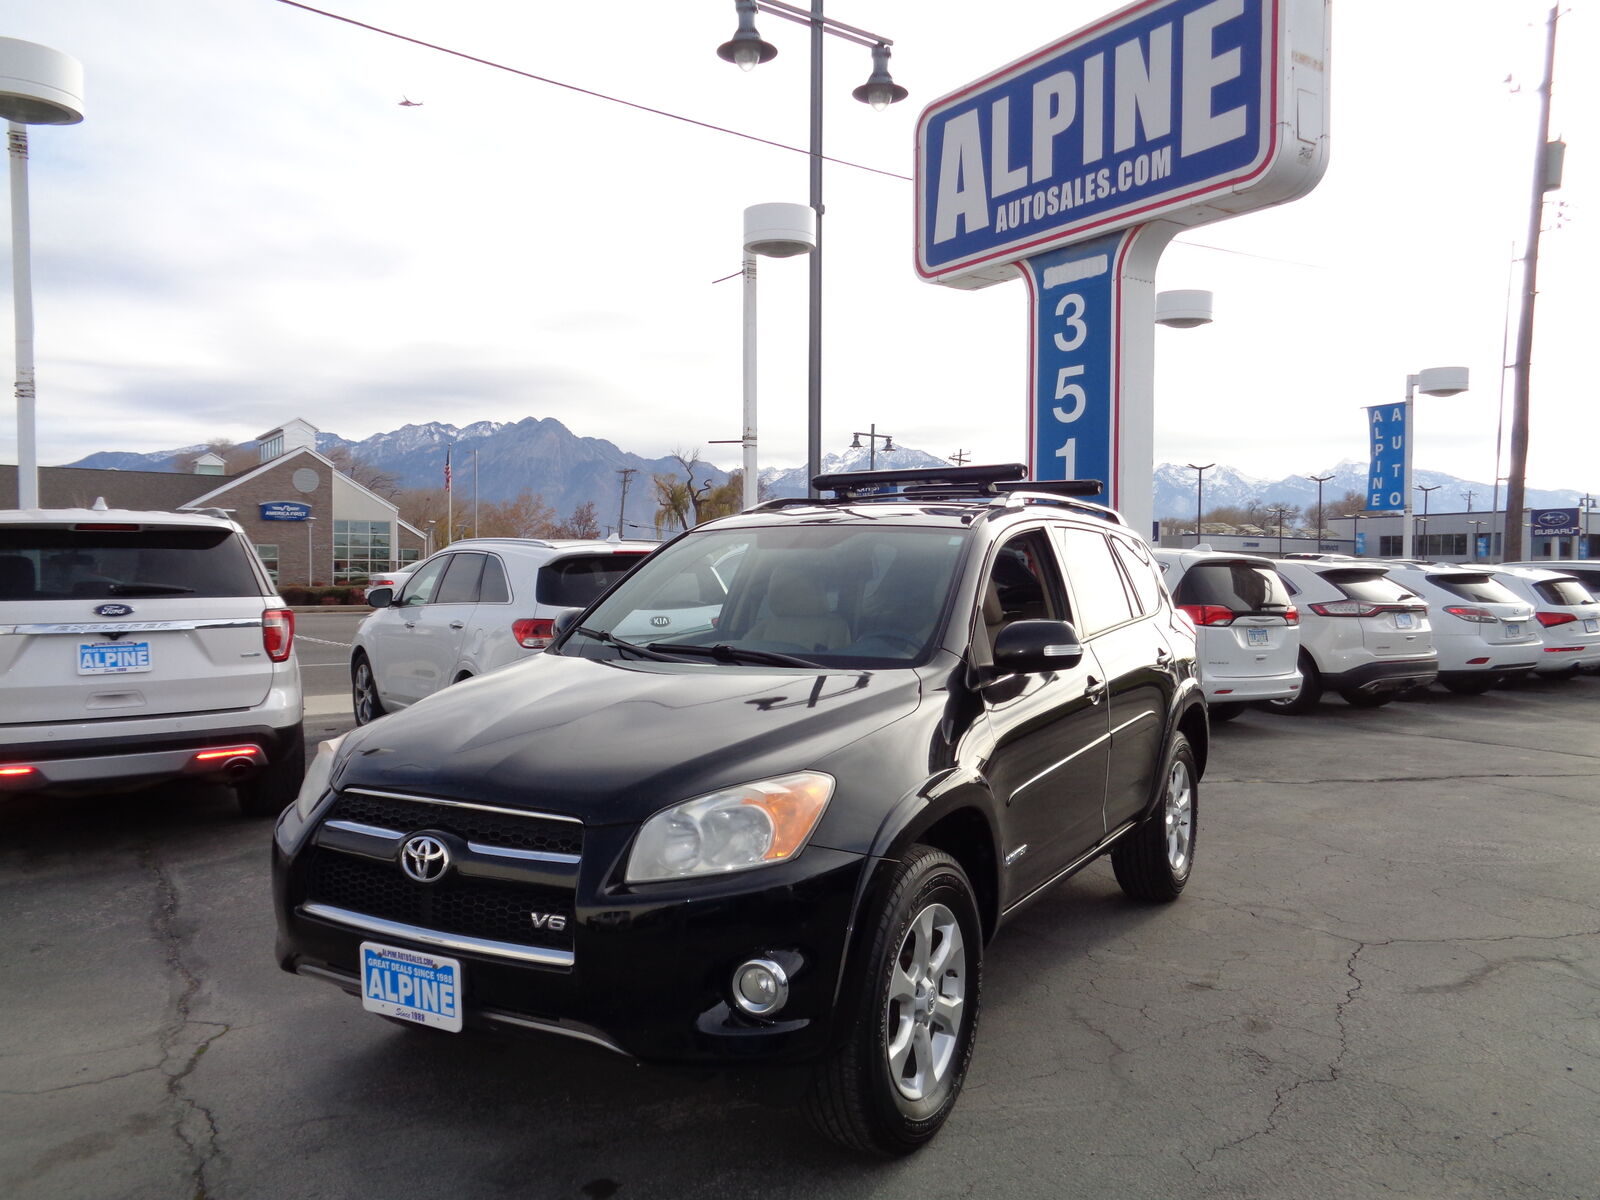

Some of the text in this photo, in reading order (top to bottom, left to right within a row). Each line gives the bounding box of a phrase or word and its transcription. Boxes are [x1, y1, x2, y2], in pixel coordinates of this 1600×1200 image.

[933, 0, 1248, 245] ALPINE
[994, 145, 1172, 234] AUTOSALES.COM
[1371, 410, 1384, 507] ALPINE
[1389, 407, 1403, 507] AUTO
[1534, 528, 1575, 536] SUBARU
[101, 606, 126, 615] Ford
[653, 617, 668, 625] KIA
[82, 651, 149, 669] ALPINE
[530, 911, 566, 932] V6
[367, 957, 453, 984] GREAT DEALS SINCE 1988
[368, 968, 455, 1016] ALPINE
[410, 1010, 426, 1023] 1988
